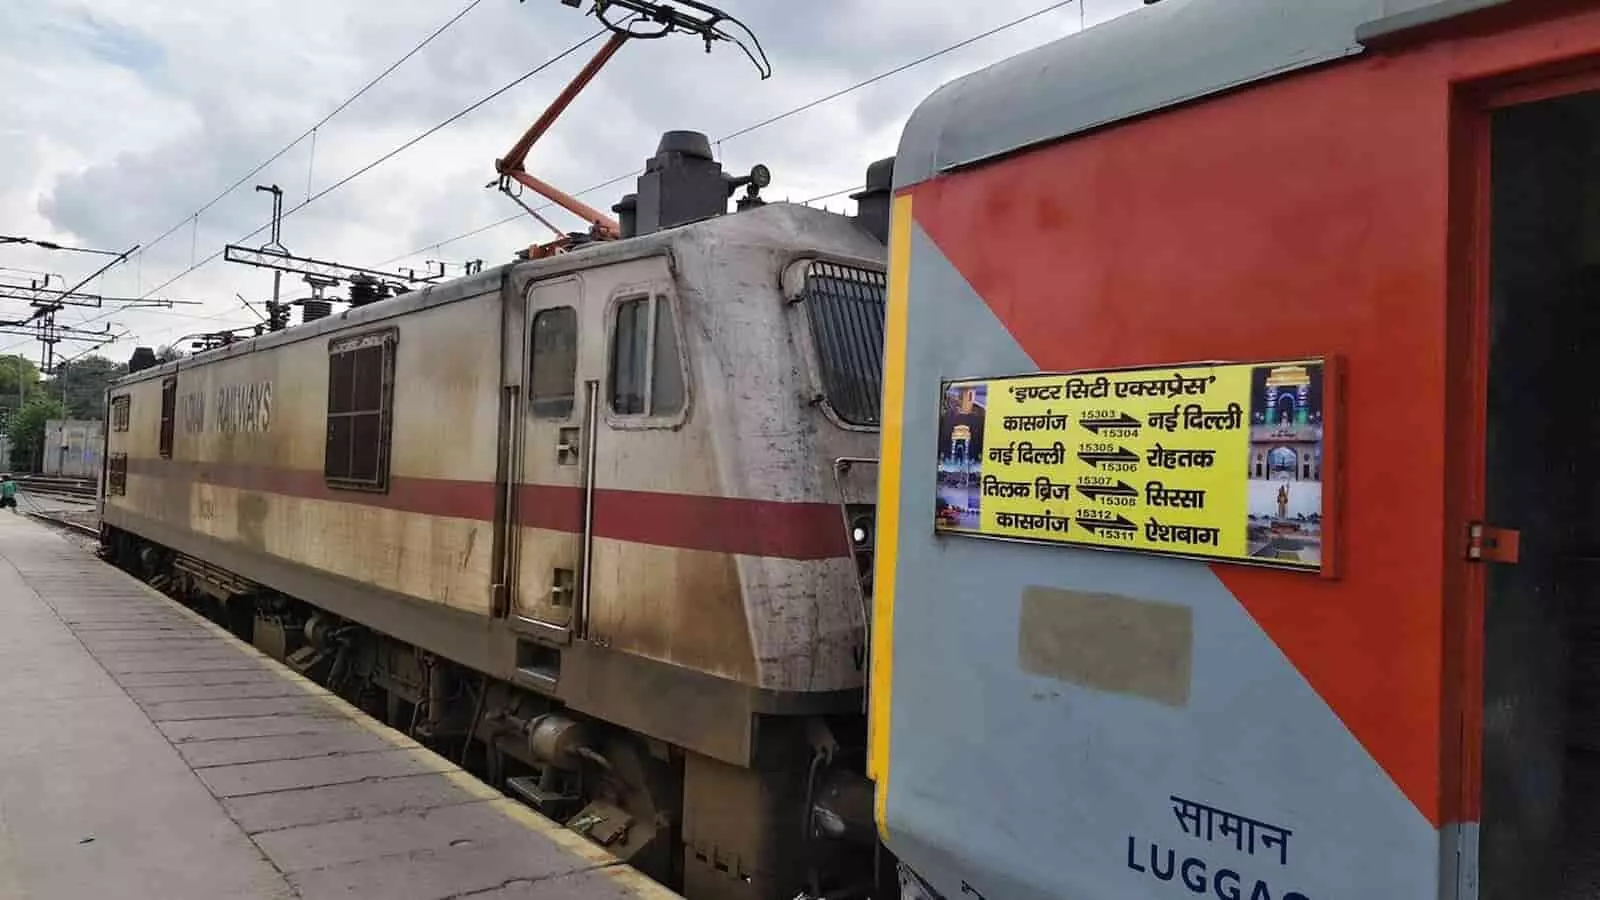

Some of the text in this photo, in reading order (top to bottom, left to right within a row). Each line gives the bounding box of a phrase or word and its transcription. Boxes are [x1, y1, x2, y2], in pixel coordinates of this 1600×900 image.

[1065, 377, 1110, 399] सिटी
[216, 381, 273, 433] RAILWAYS
[1082, 410, 1115, 418] 15303
[1148, 402, 1242, 432] नई दिल्ली
[1003, 410, 1067, 431] कासगंज
[1103, 430, 1138, 438] 15304
[989, 441, 1065, 466] नई दिल्ली
[1080, 444, 1113, 452] 15305
[1147, 443, 1216, 469] रोहतक
[1102, 464, 1137, 472] 15306
[983, 475, 1070, 502] तिलक ब्रिज
[1078, 476, 1112, 485] 15307
[1100, 497, 1136, 506] 15308
[996, 510, 1070, 532] कासगंज
[1077, 509, 1111, 518] 15312
[1099, 530, 1133, 540] 15311
[1145, 518, 1219, 546] ऐशबाग
[1169, 795, 1293, 865] सामान
[1127, 835, 1310, 900] LUGGA
